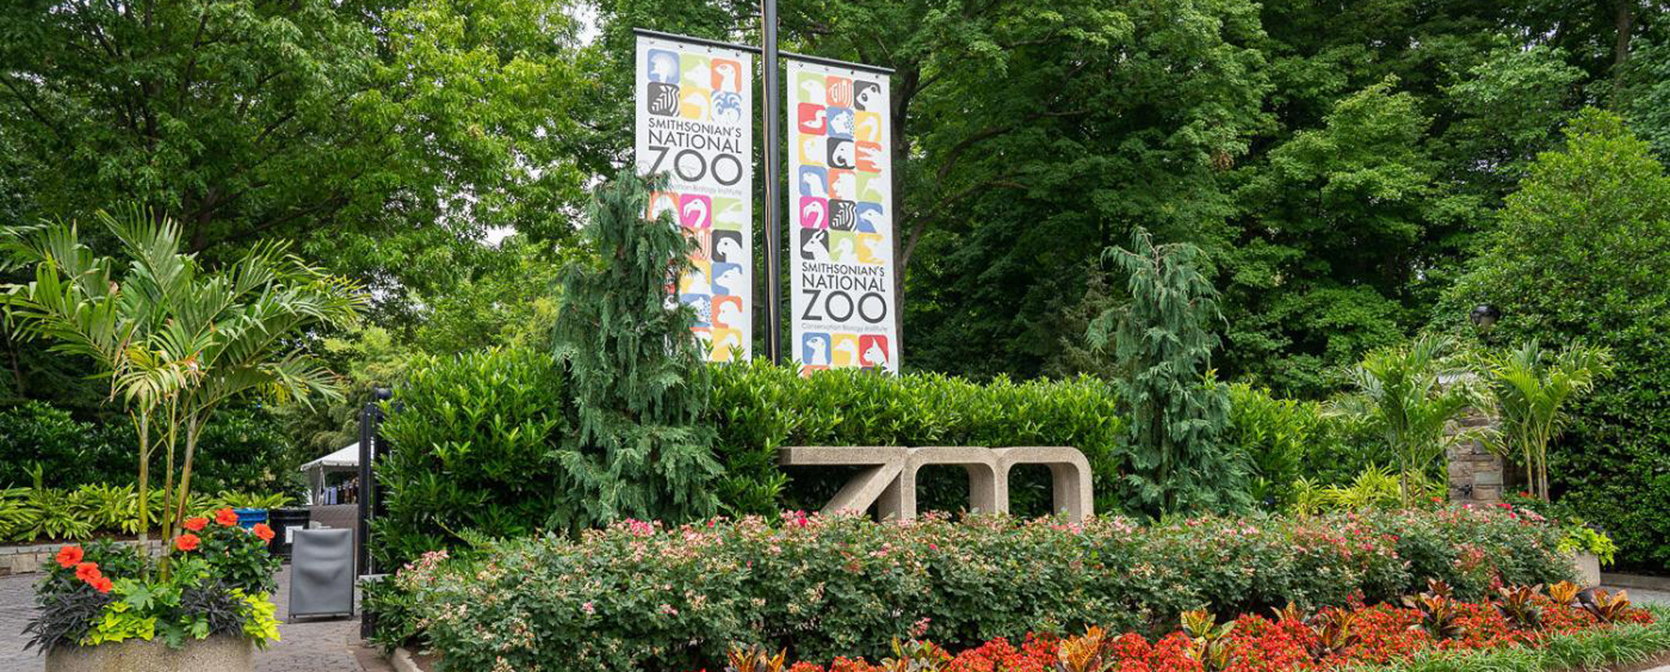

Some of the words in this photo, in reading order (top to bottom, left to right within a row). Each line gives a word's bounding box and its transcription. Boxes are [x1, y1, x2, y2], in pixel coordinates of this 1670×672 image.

[648, 117, 742, 138] SMITHSONIAN'S
[648, 128, 742, 153] NATIONAL
[648, 145, 743, 186] ZOO
[802, 262, 885, 277] SMITHSONIAN'S
[802, 273, 886, 292] NATIONAL
[801, 289, 887, 324] ZOO
